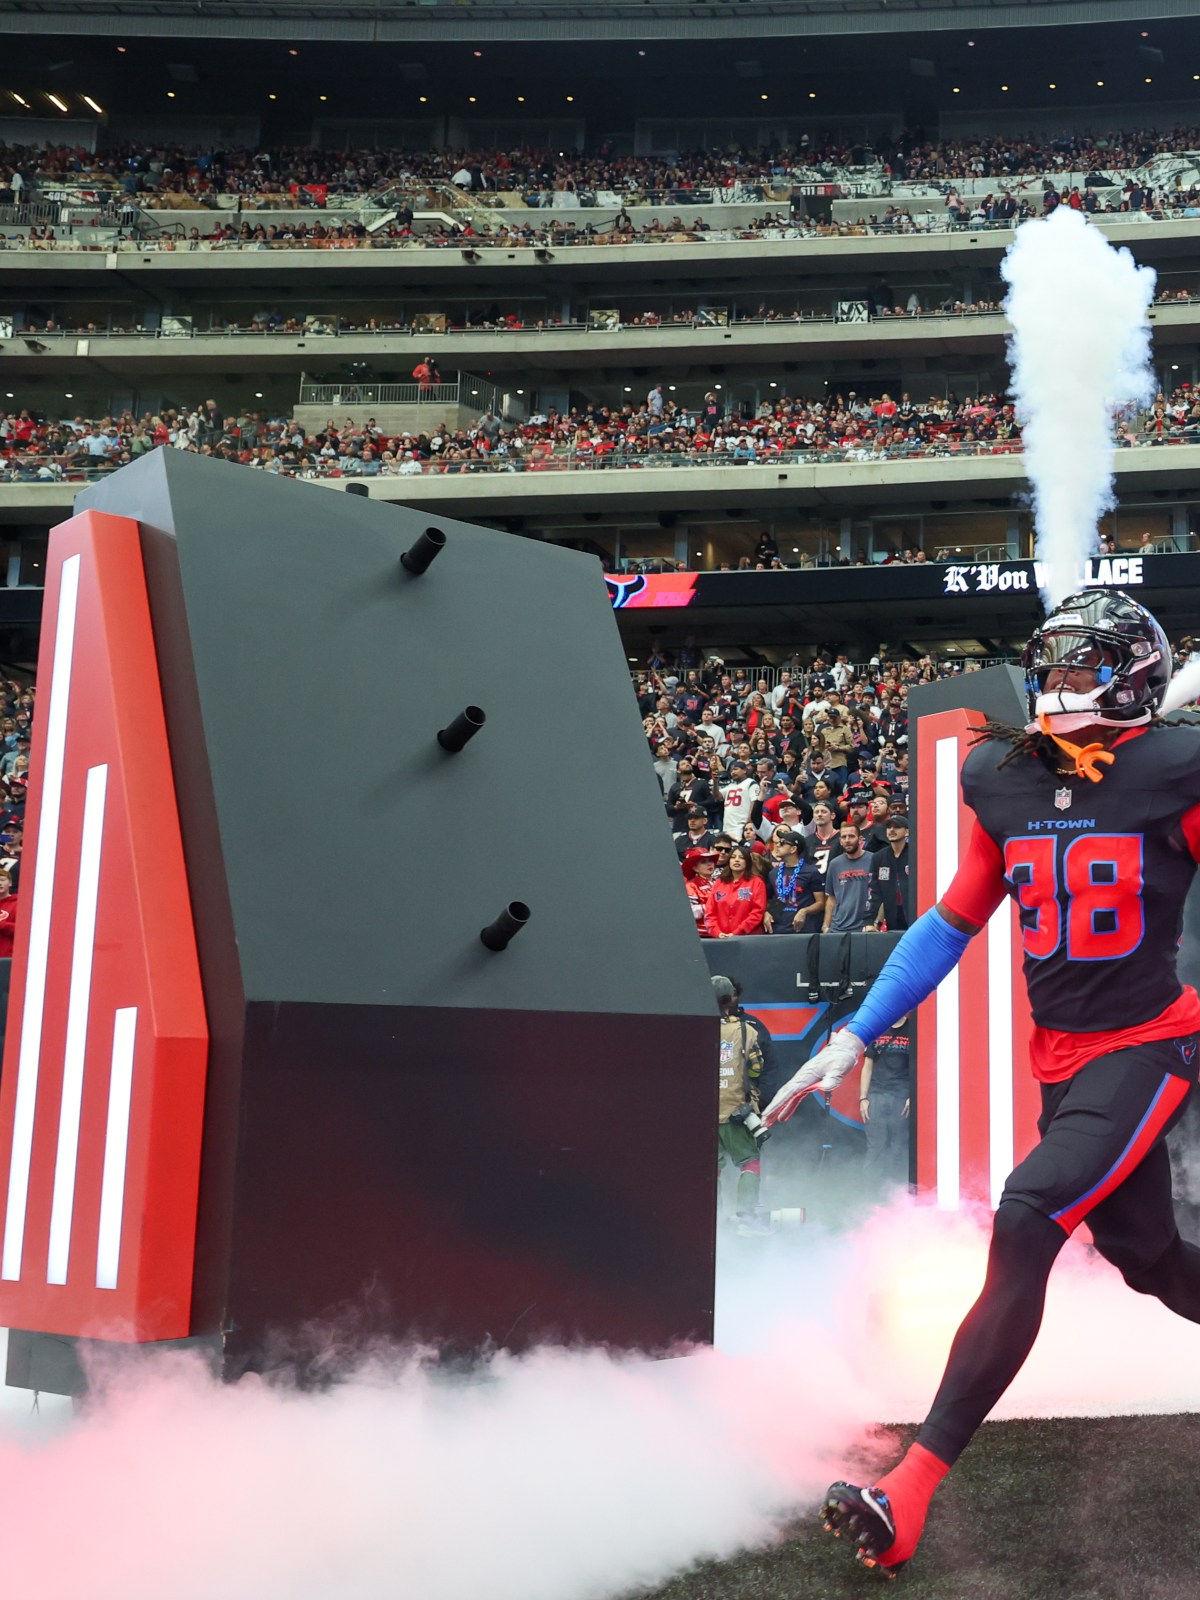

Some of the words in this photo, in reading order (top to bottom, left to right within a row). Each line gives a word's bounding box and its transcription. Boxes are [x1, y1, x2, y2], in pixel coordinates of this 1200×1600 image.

[943, 564, 1030, 593] K'Von
[724, 788, 743, 807] 56
[1027, 818, 1096, 831] H-TOWN
[1004, 832, 1145, 962] 38
